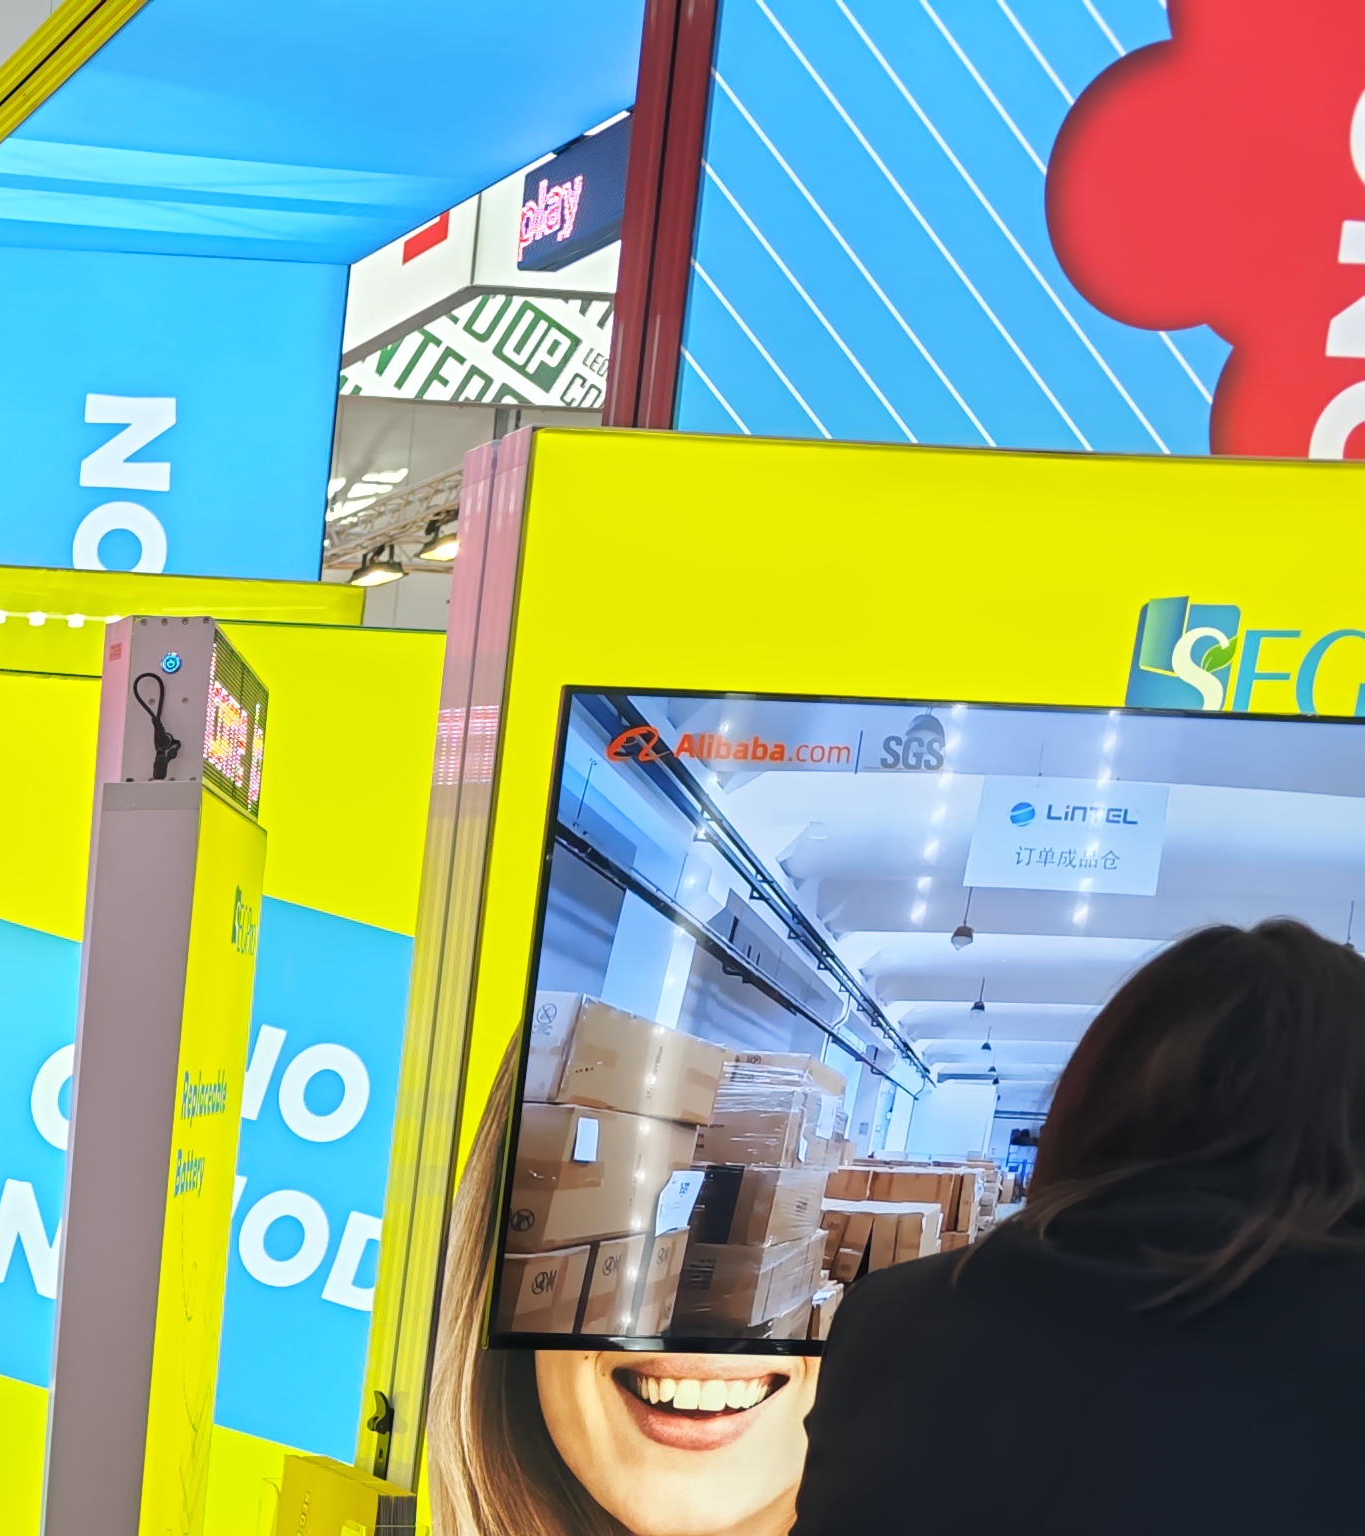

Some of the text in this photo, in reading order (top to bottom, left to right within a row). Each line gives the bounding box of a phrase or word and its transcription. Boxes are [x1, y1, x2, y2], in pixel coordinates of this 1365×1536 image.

[674, 733, 851, 764] Alibaba.com
[880, 735, 946, 771] SGS
[1015, 846, 1120, 870] 订单成品仓
[173, 1148, 205, 1199] Battery
